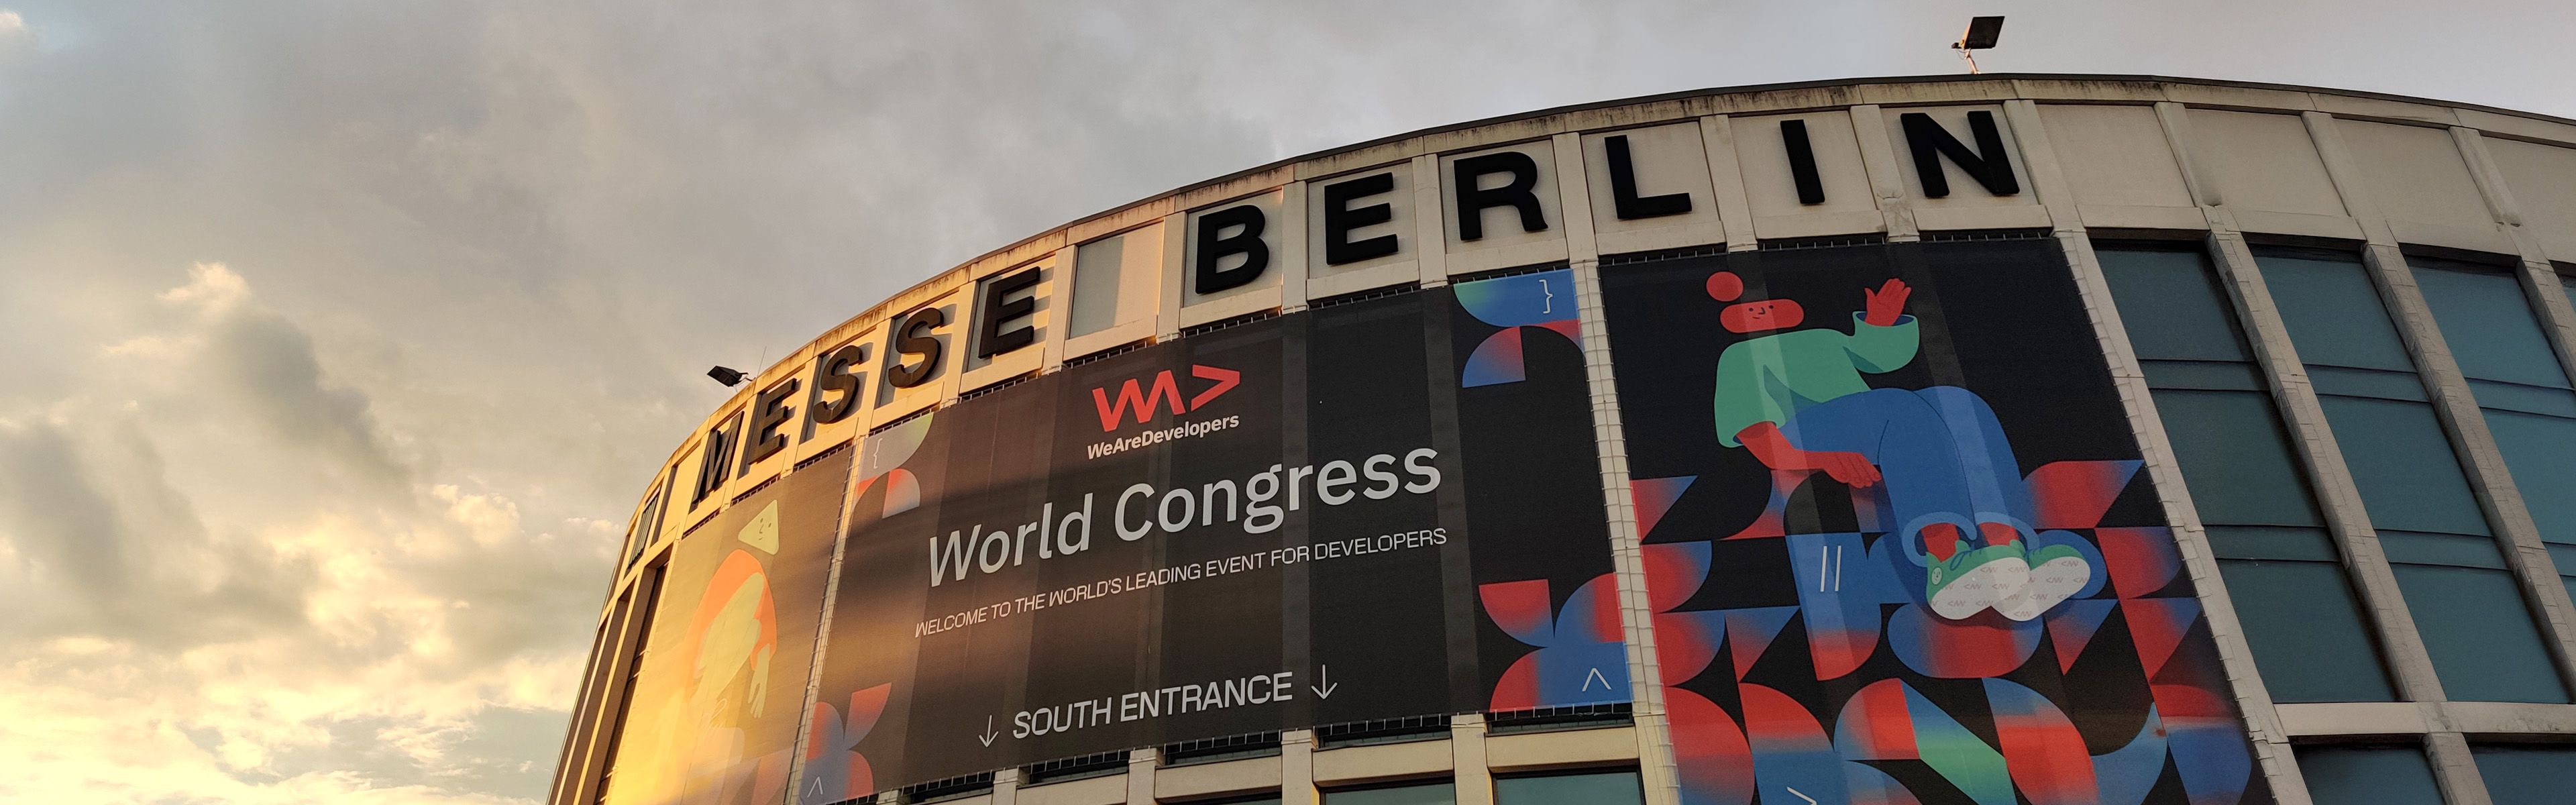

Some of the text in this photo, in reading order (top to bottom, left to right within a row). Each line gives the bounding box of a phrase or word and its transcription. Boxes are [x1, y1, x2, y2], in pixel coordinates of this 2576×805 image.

[689, 110, 2021, 514] MESSE BERLIN
[1087, 414, 1240, 460] WeAreDevelopers
[929, 447, 1442, 588] World Congress
[915, 527, 1447, 637] WELCOME TO THE WORLD'S LEADING EVENT FOR DEVELOPERS
[1013, 672, 1293, 739] SOUTH ENTRANCE
